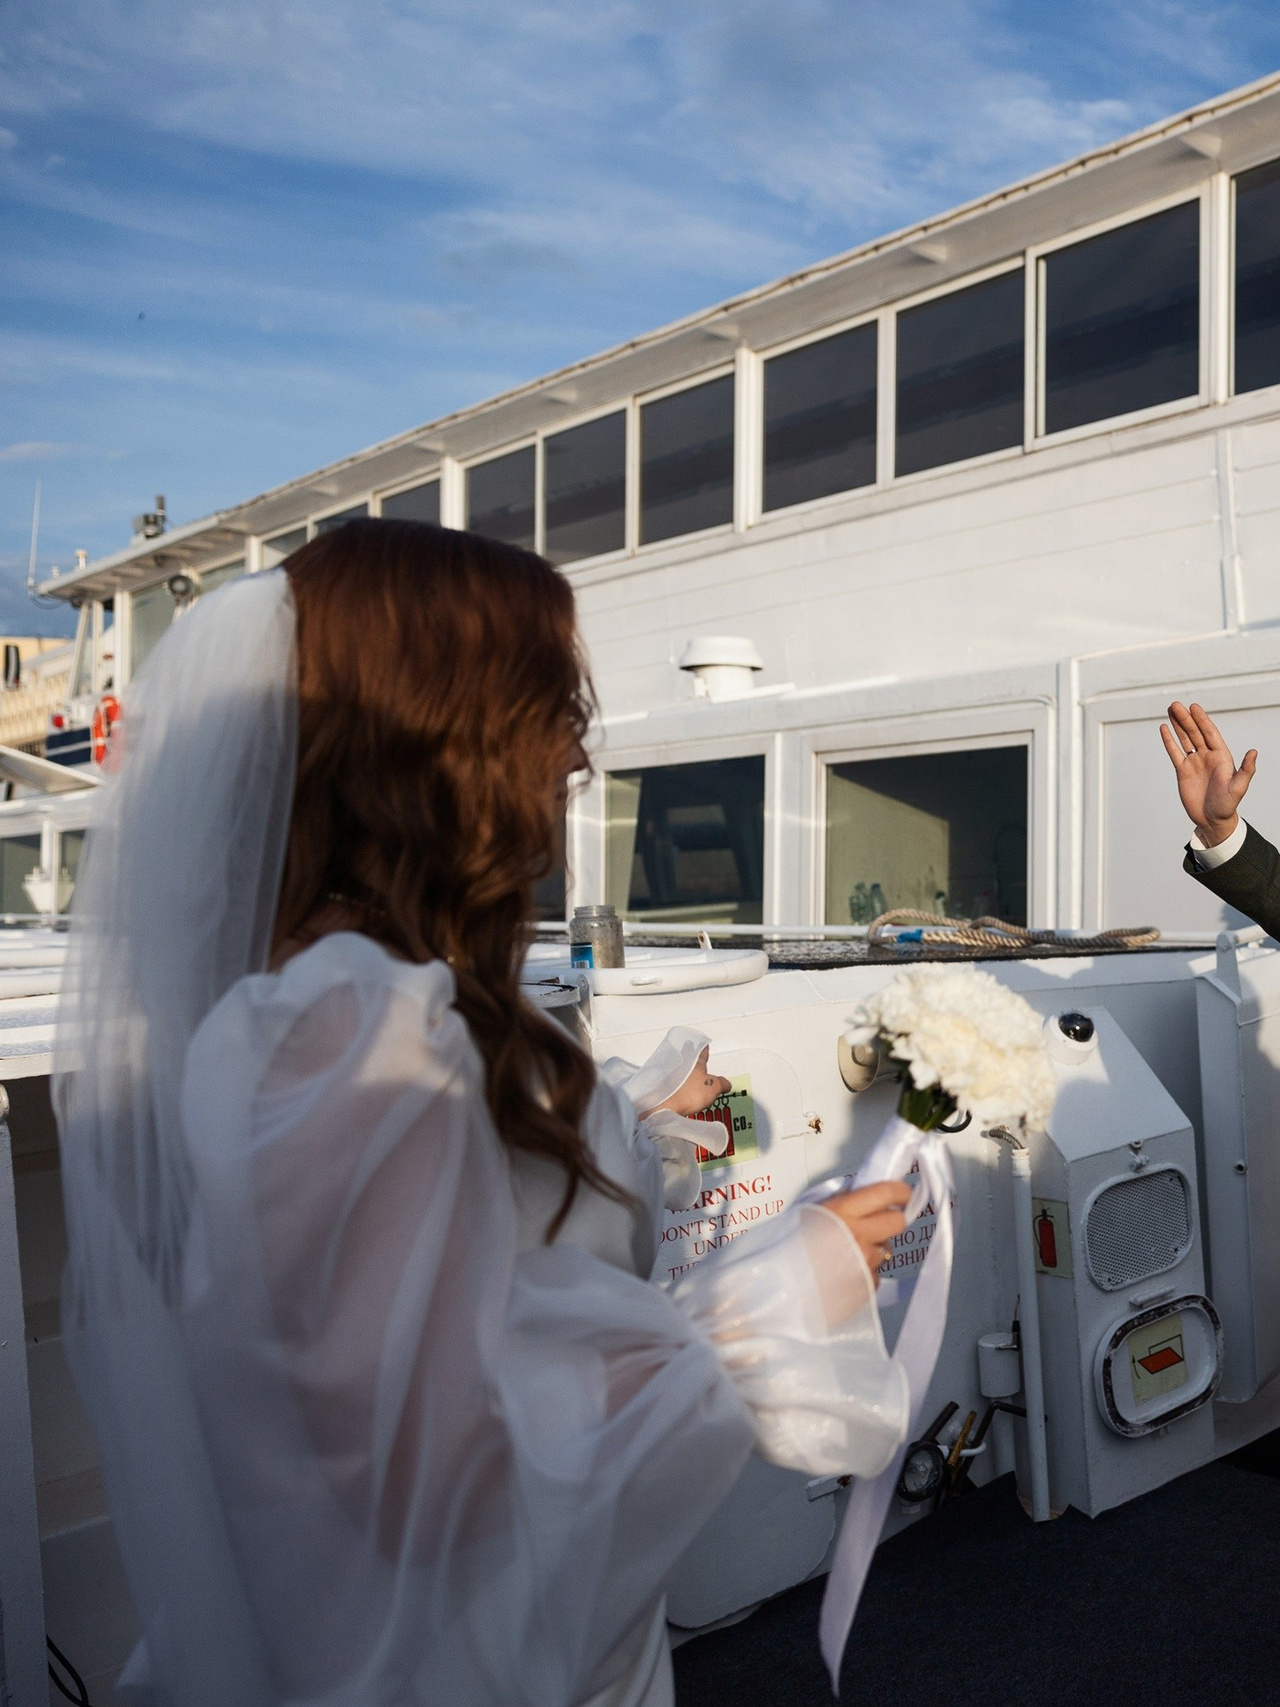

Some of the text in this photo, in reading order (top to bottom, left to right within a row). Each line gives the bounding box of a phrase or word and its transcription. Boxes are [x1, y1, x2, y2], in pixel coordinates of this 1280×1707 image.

[671, 1175, 772, 1215] RNING!
[708, 1206, 761, 1232] STAND
[764, 1199, 784, 1216] UP
[919, 1223, 937, 1243] ДЛ
